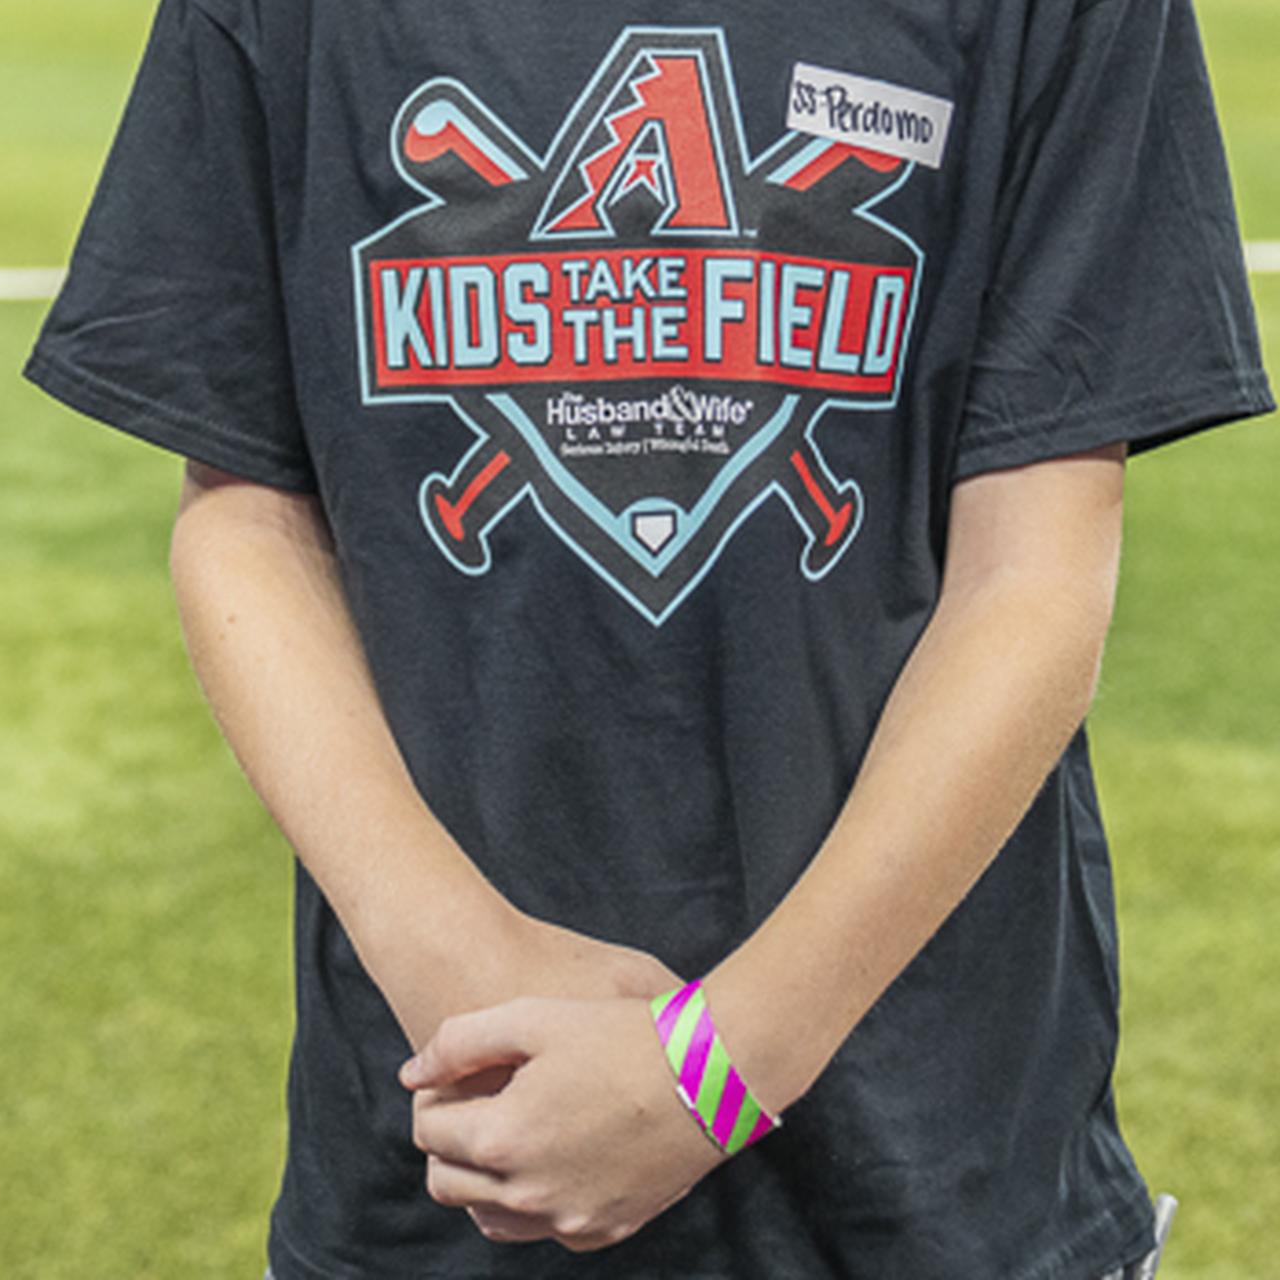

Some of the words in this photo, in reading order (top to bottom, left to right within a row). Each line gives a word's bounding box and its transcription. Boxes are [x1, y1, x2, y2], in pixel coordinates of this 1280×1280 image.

[381, 262, 551, 369] KIDS
[562, 257, 687, 302] TAKE
[704, 258, 906, 376] FIELD
[563, 306, 689, 364] THE
[566, 425, 626, 441] LAW
[654, 423, 725, 437] TEAM
